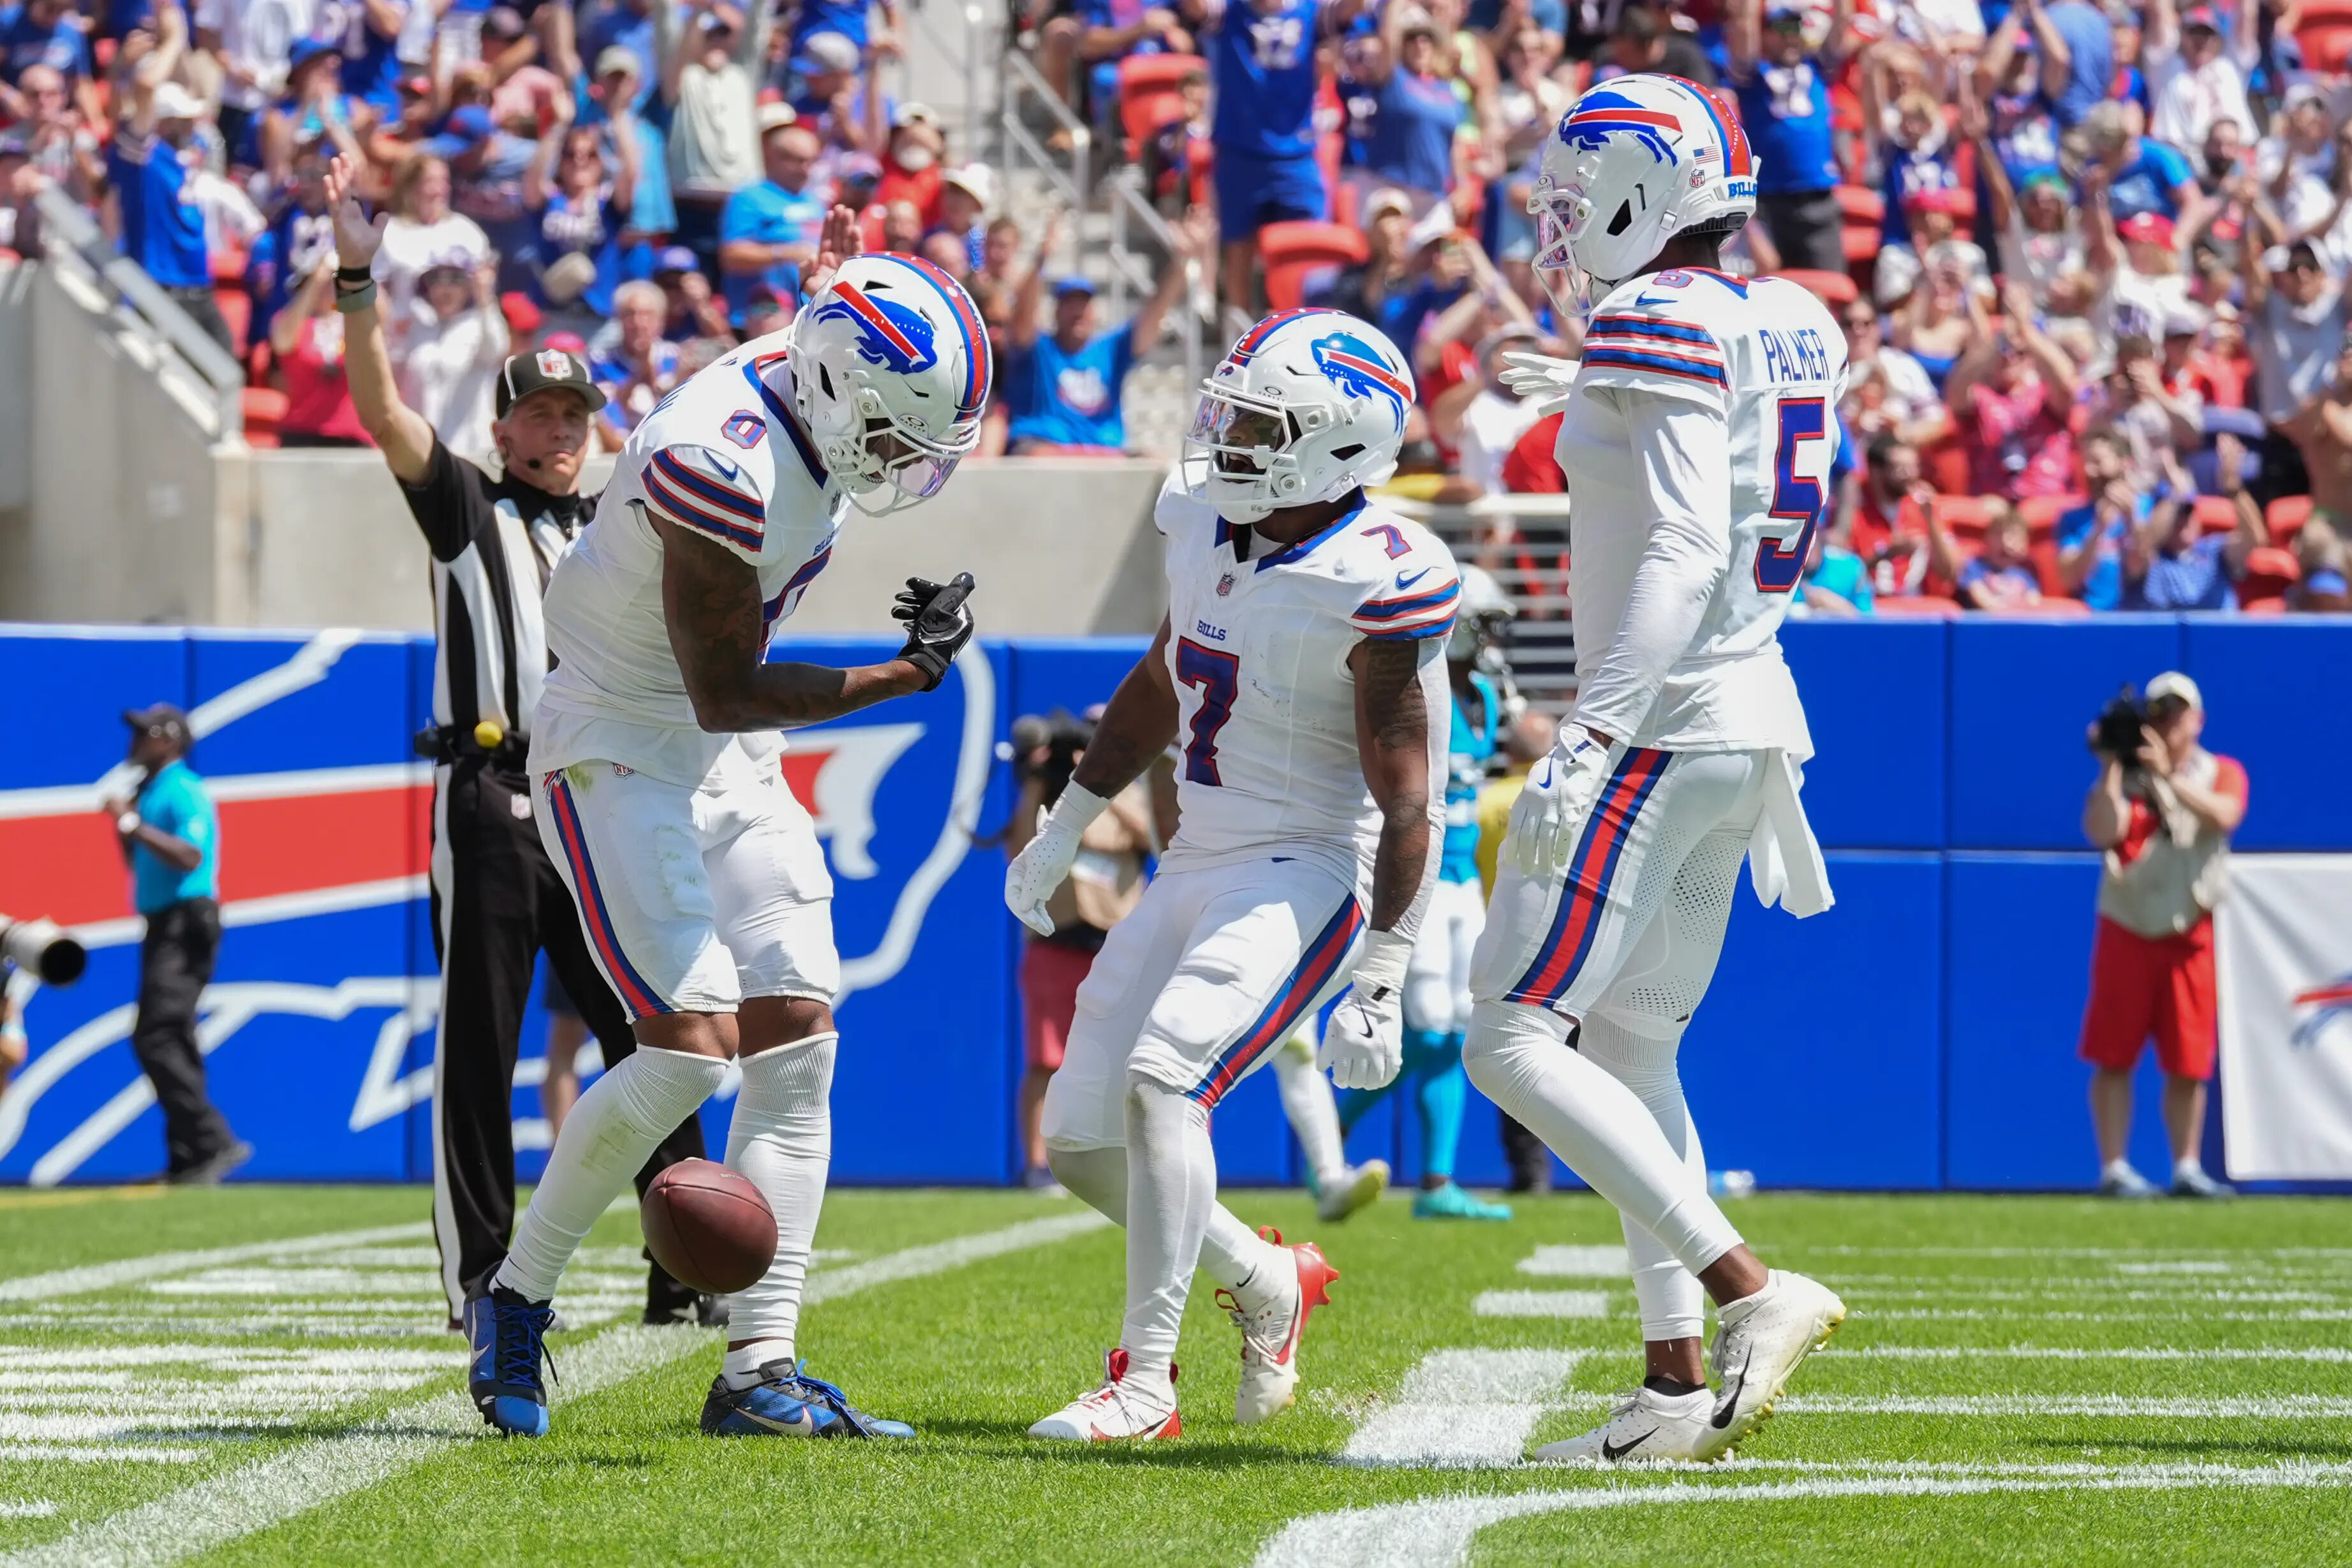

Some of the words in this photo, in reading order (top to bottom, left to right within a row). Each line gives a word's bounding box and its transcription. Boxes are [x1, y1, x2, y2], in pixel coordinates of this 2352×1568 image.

[1758, 329, 1830, 383] PALMER
[1753, 396, 1825, 592] 5
[1359, 524, 1413, 561] 7
[1197, 619, 1227, 641] BILLS
[1175, 635, 1240, 787] 7
